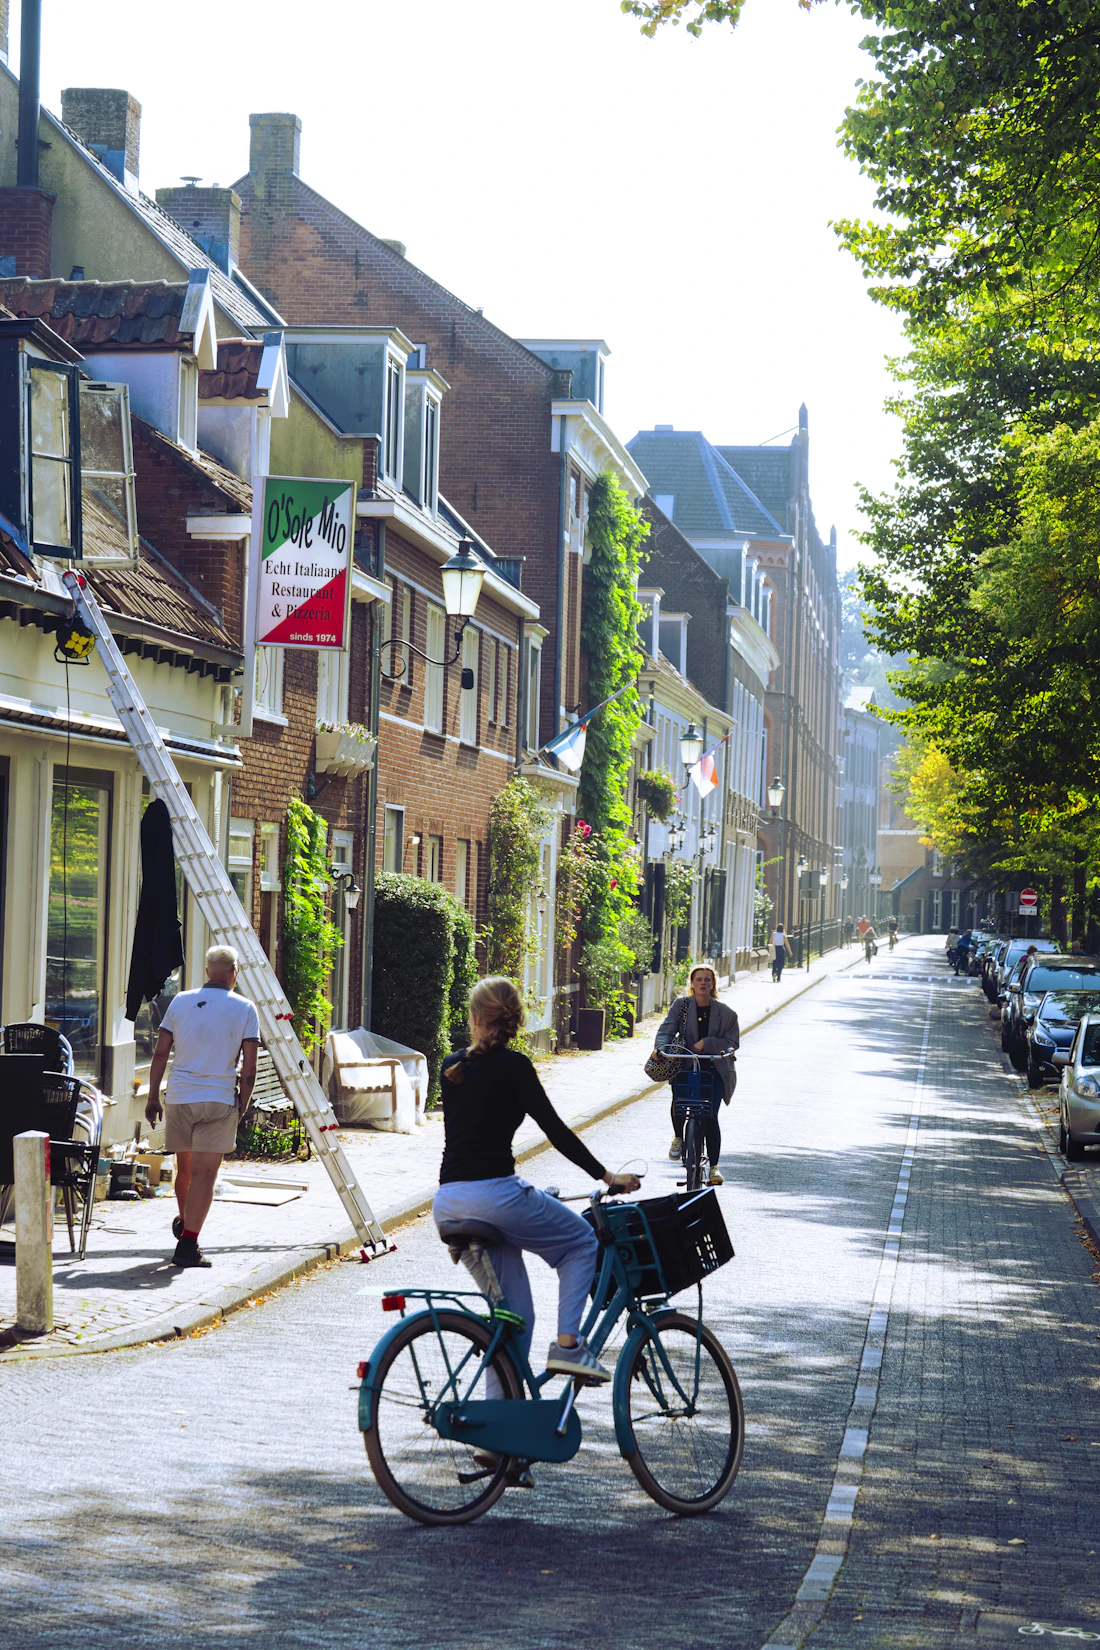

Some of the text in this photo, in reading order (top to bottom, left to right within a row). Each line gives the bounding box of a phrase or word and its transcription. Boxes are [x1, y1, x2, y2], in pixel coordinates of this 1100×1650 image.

[267, 493, 346, 554] O'Sole Mio
[265, 560, 343, 579] Echt Italiaans
[271, 582, 334, 600] Restaurant
[271, 603, 331, 621] & Pizzeria
[289, 632, 337, 643] sinds 1974
